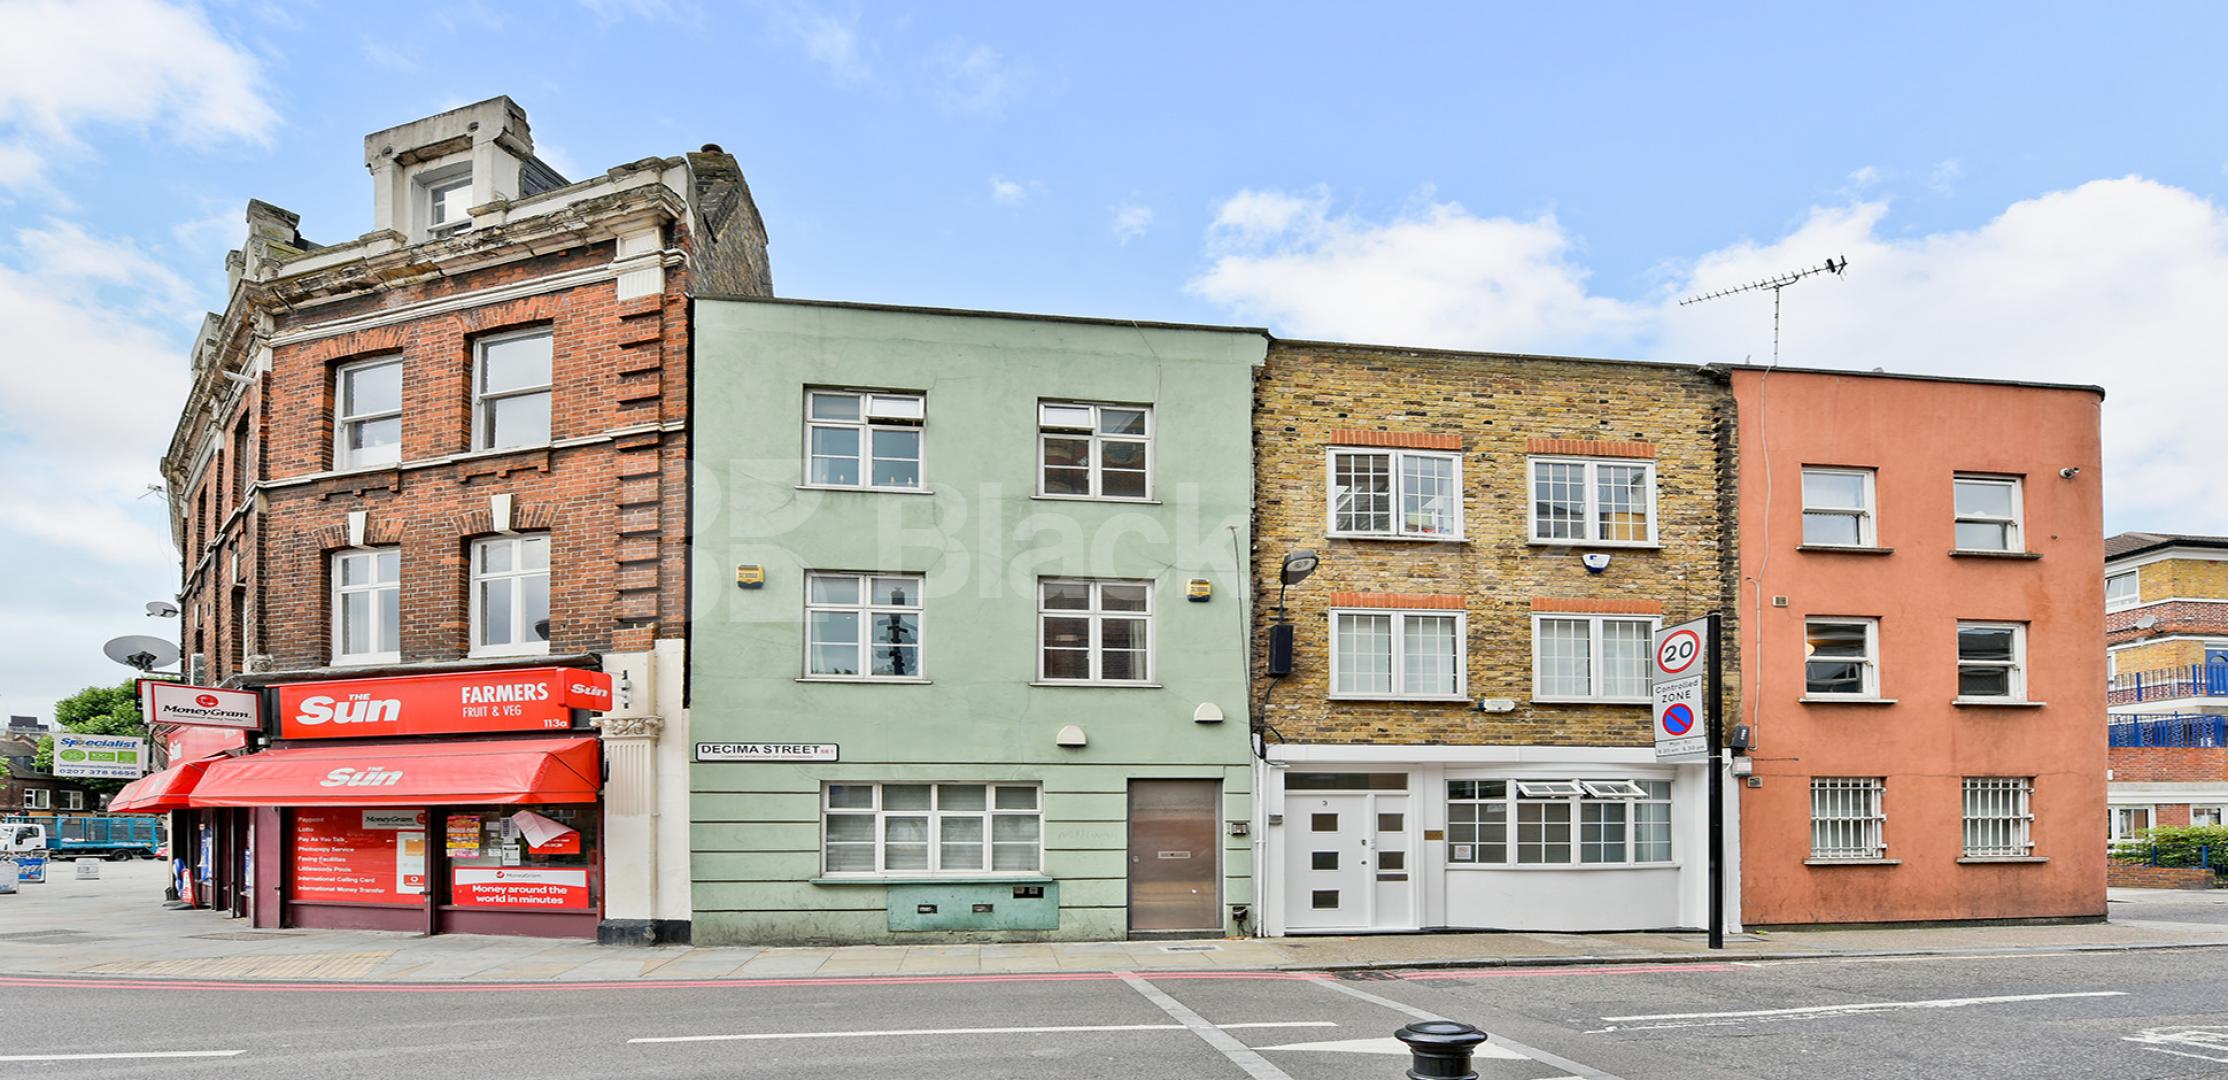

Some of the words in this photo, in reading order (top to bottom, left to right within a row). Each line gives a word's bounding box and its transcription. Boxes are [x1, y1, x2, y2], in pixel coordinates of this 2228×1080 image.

[1663, 640, 1694, 663] 20
[461, 682, 549, 704] FARMERS
[570, 683, 608, 697] Sun
[1655, 680, 1699, 694] Controlled
[348, 693, 371, 701] THE
[1661, 690, 1692, 703] ZONE
[163, 705, 249, 718] MoneyGram
[295, 695, 402, 725] Sun
[462, 706, 488, 718] FRUIT
[491, 706, 500, 717] &
[502, 705, 522, 716] VEG
[543, 719, 568, 728] 113a
[701, 745, 759, 754] DECIMA
[762, 745, 820, 754] STREET
[319, 767, 404, 787] Sun
[472, 885, 507, 895] Money
[508, 885, 547, 894] around
[549, 885, 568, 894] the
[475, 895, 506, 903] world
[507, 895, 518, 903] in
[519, 896, 564, 904] minutes
